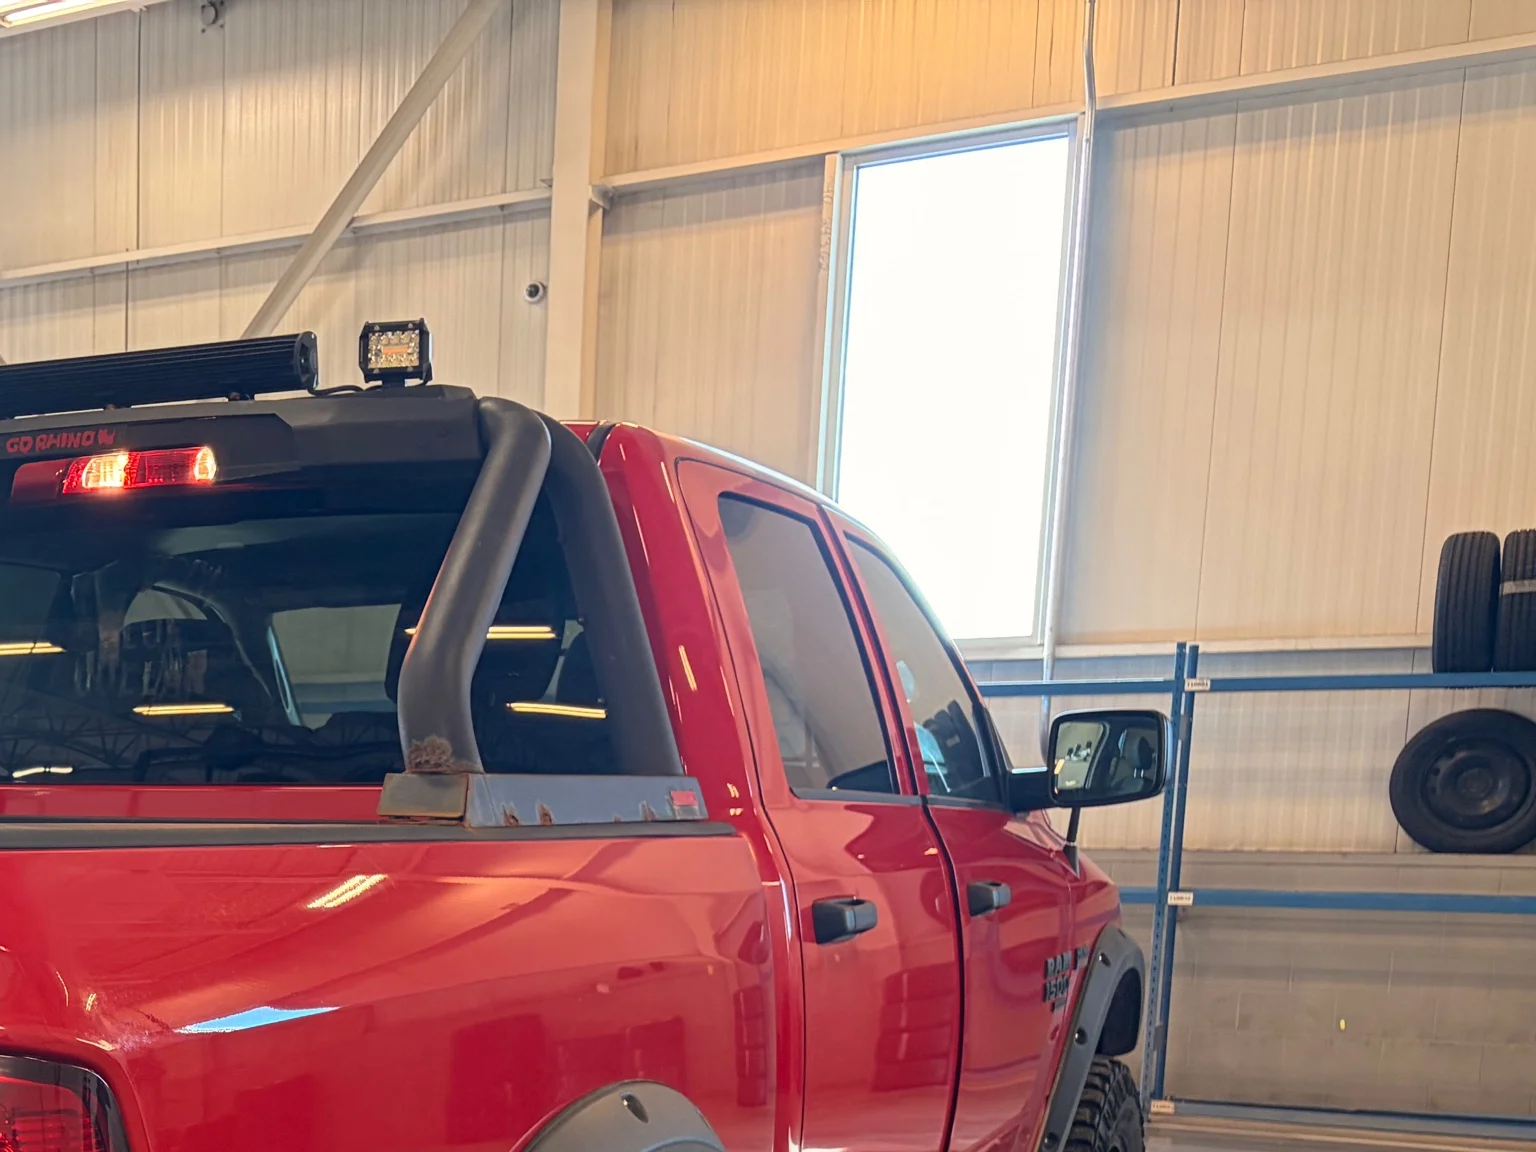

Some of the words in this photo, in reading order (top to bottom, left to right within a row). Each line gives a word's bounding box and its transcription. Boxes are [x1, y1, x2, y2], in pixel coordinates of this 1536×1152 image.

[5, 435, 34, 454] GO
[35, 430, 96, 453] RHINO
[1044, 950, 1072, 980] RAM
